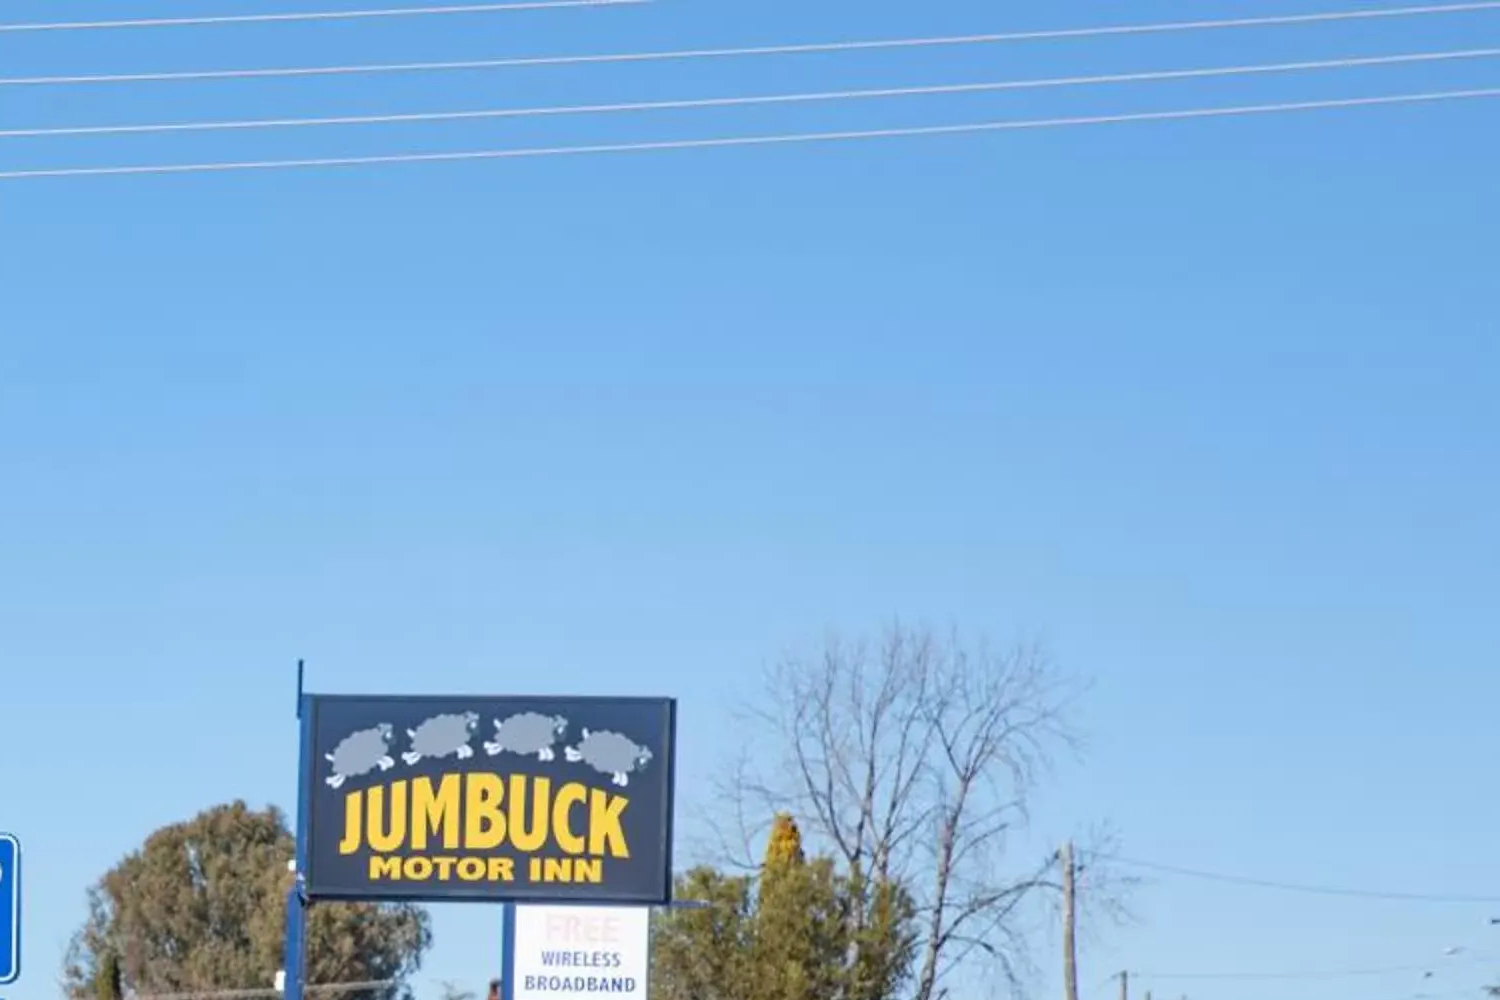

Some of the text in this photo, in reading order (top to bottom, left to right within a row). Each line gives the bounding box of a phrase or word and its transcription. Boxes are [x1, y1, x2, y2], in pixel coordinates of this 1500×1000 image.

[339, 772, 630, 859] JUMBUCK
[368, 856, 604, 884] MOTOR INN
[545, 912, 621, 943] FREE
[541, 950, 621, 968] WIRELESS
[524, 974, 637, 993] BROADBAND
